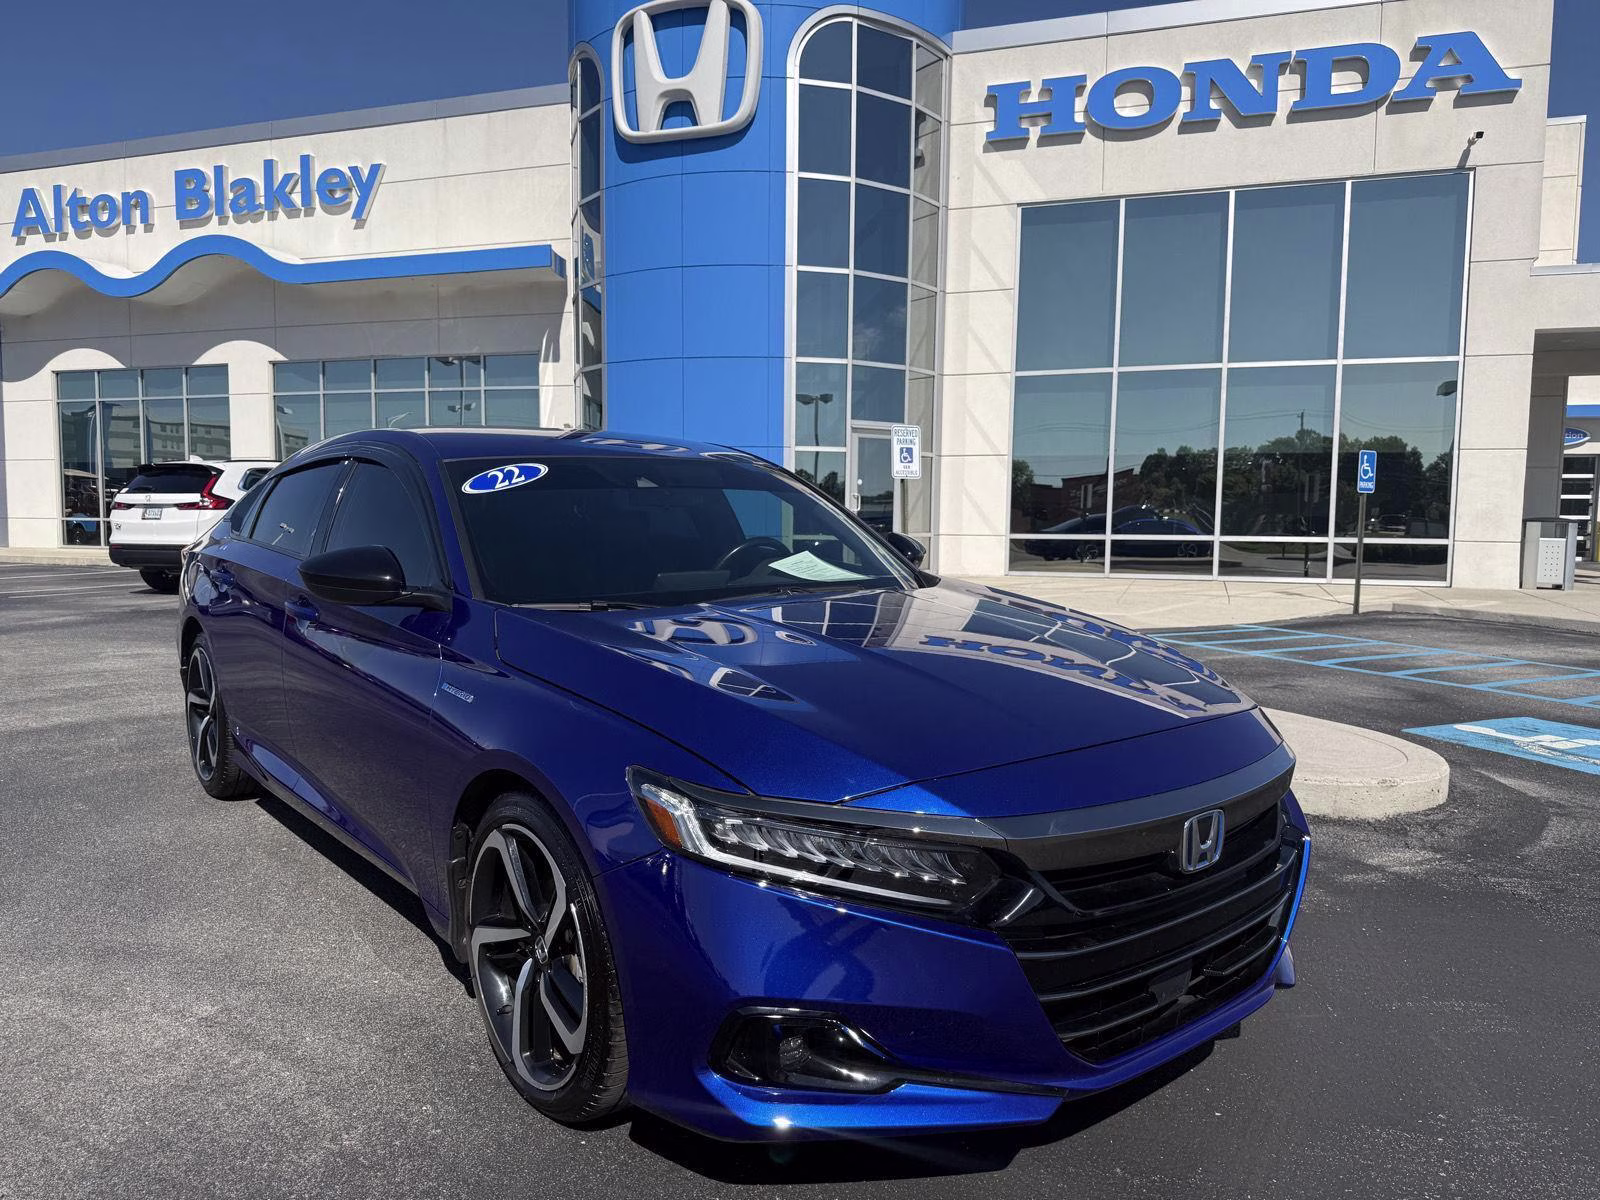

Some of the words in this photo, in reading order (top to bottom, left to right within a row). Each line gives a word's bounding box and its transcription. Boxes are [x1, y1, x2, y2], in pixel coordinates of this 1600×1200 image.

[985, 30, 1523, 143] HONDA
[11, 184, 150, 238] Alton
[174, 154, 384, 221] Blakley
[894, 429, 917, 438] RESERVED
[487, 466, 526, 489] 22
[1359, 481, 1374, 489] PARKING
